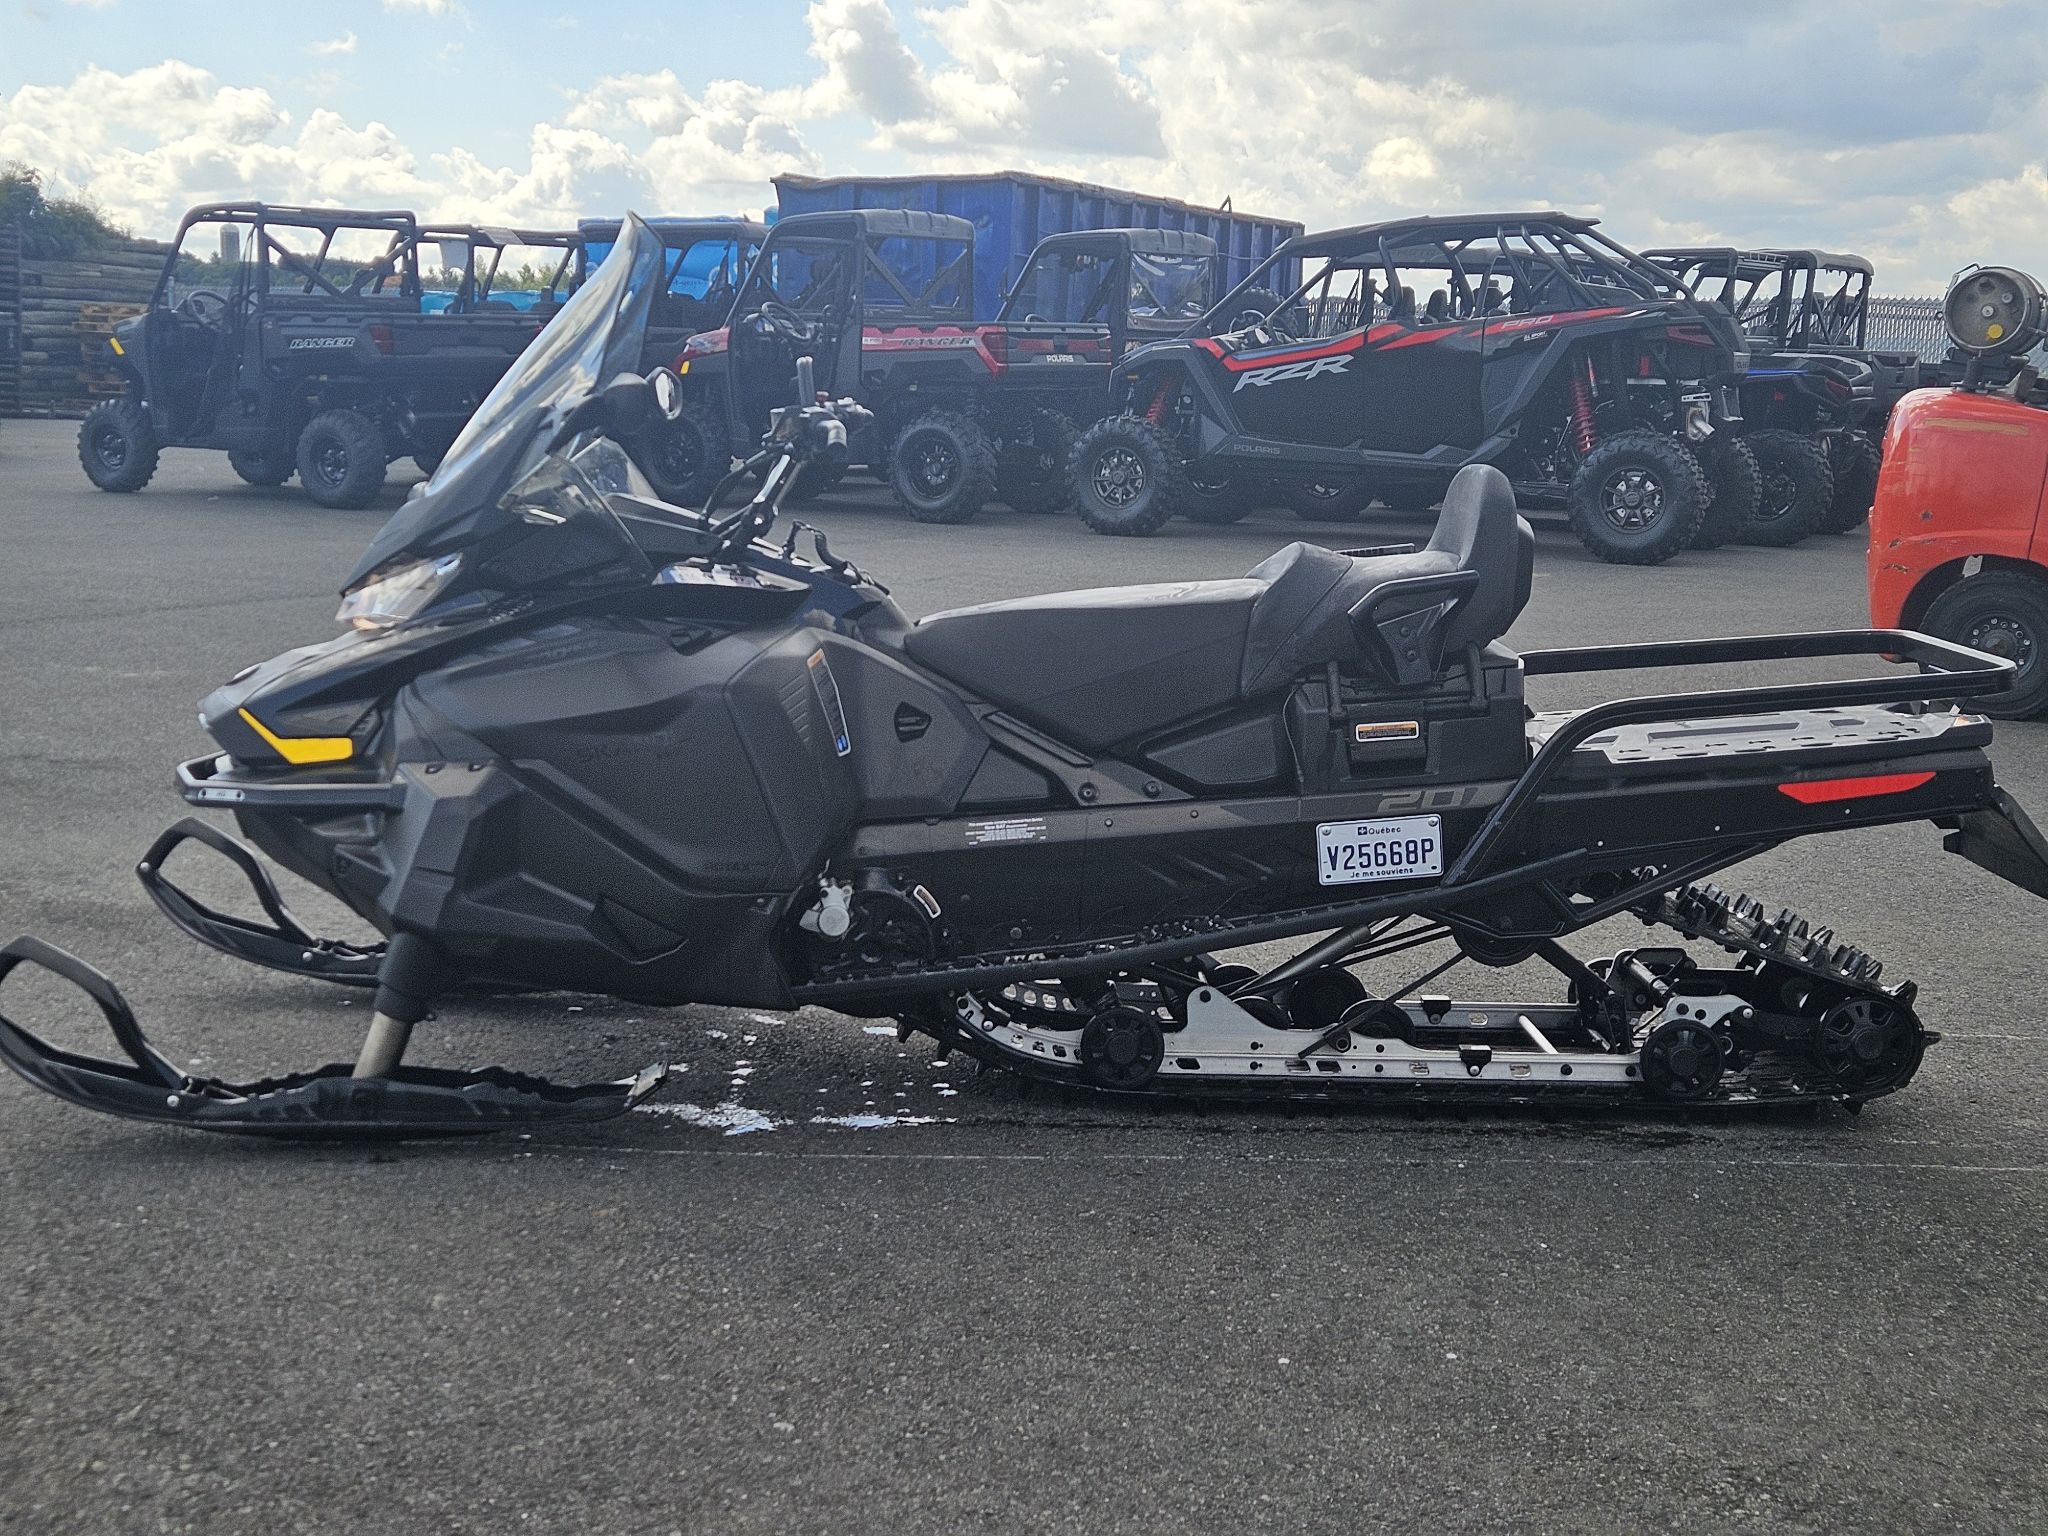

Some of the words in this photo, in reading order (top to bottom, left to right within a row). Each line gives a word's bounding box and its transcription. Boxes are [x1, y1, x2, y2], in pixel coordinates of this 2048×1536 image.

[1501, 315, 1554, 329] PRO
[289, 337, 355, 349] RANGER
[901, 337, 973, 346] RANGER
[1046, 354, 1074, 363] POLARIS
[1232, 354, 1354, 393] RZR
[1233, 443, 1280, 455] POLARIS
[1368, 826, 1401, 835] Québec
[1326, 838, 1434, 871] V25668P
[1350, 870, 1360, 878] Je
[1376, 867, 1414, 876] souviens
